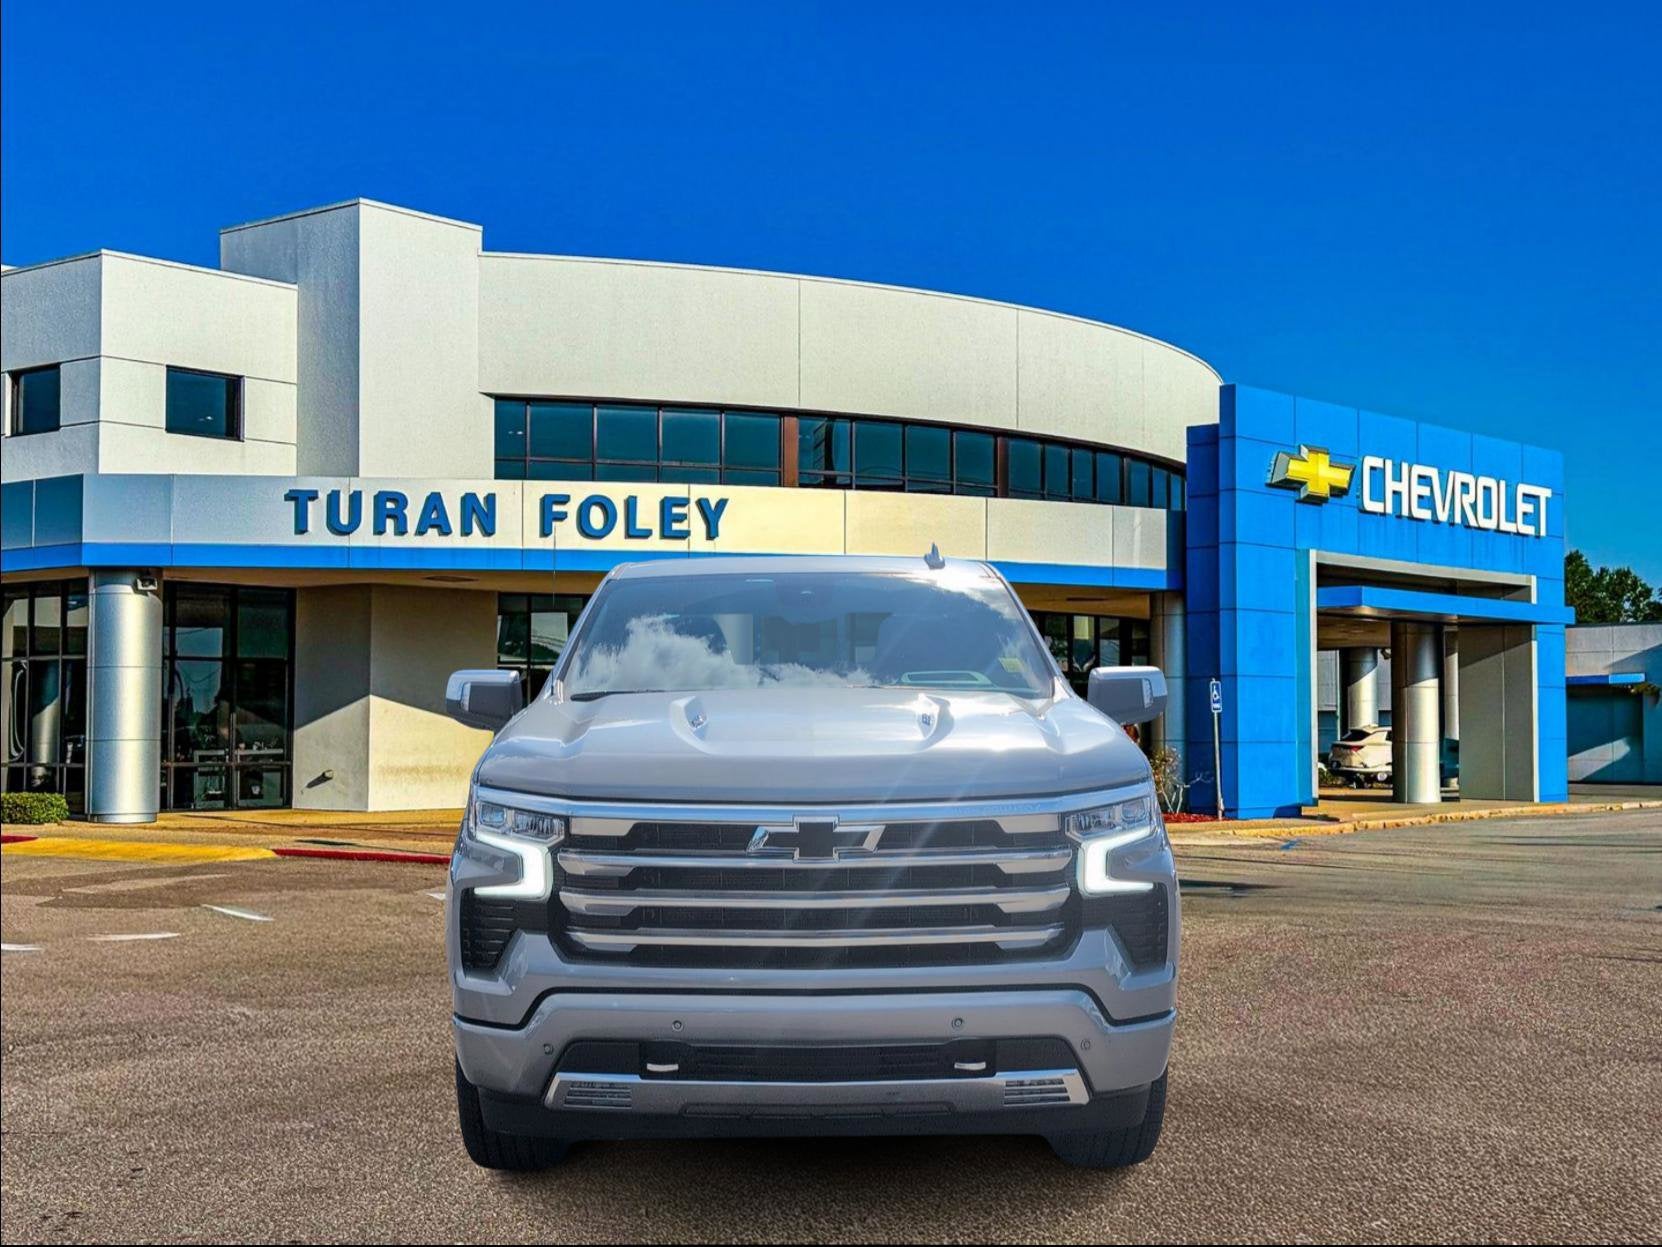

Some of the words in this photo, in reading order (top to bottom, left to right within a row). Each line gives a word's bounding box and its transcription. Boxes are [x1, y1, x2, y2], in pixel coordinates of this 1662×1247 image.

[284, 488, 496, 537] TURAN
[539, 494, 729, 541] FOLEY
[1361, 455, 1552, 537] CHEVROLET
